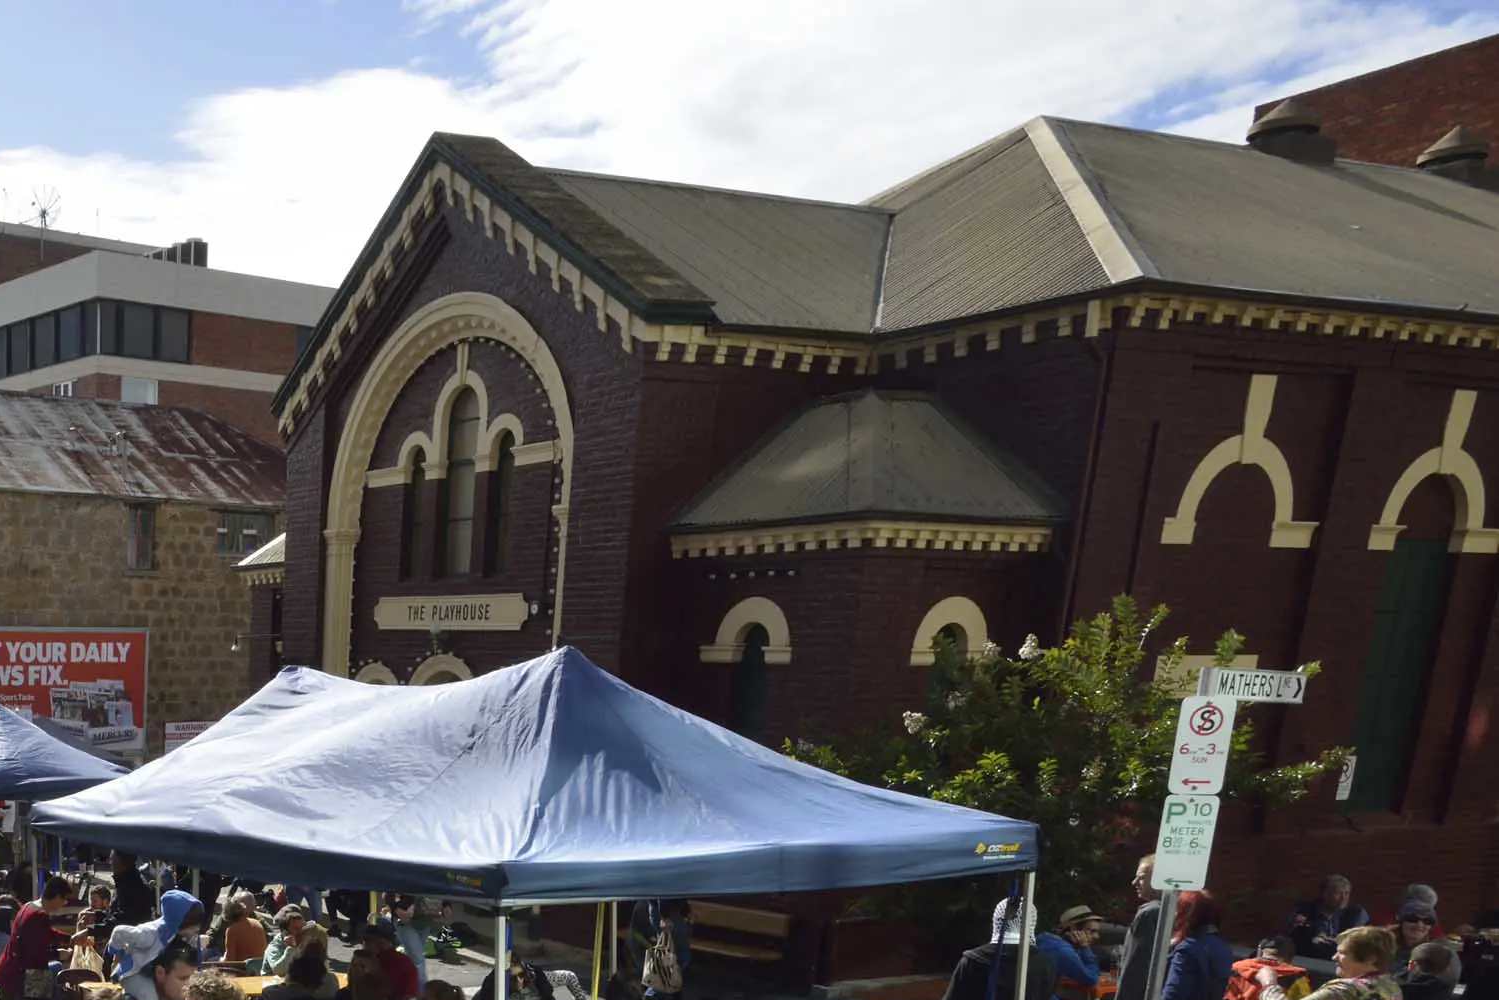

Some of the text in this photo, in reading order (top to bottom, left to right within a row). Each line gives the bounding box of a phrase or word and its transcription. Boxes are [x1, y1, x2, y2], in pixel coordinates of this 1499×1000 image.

[408, 603, 491, 622] THE PLAYHOUSE
[5, 640, 67, 663] YOUR
[70, 641, 131, 663] DAILY
[28, 664, 69, 687] FIX.
[1218, 672, 1275, 697] MATHERS
[1165, 802, 1212, 824] P 10
[1170, 826, 1204, 836] METER
